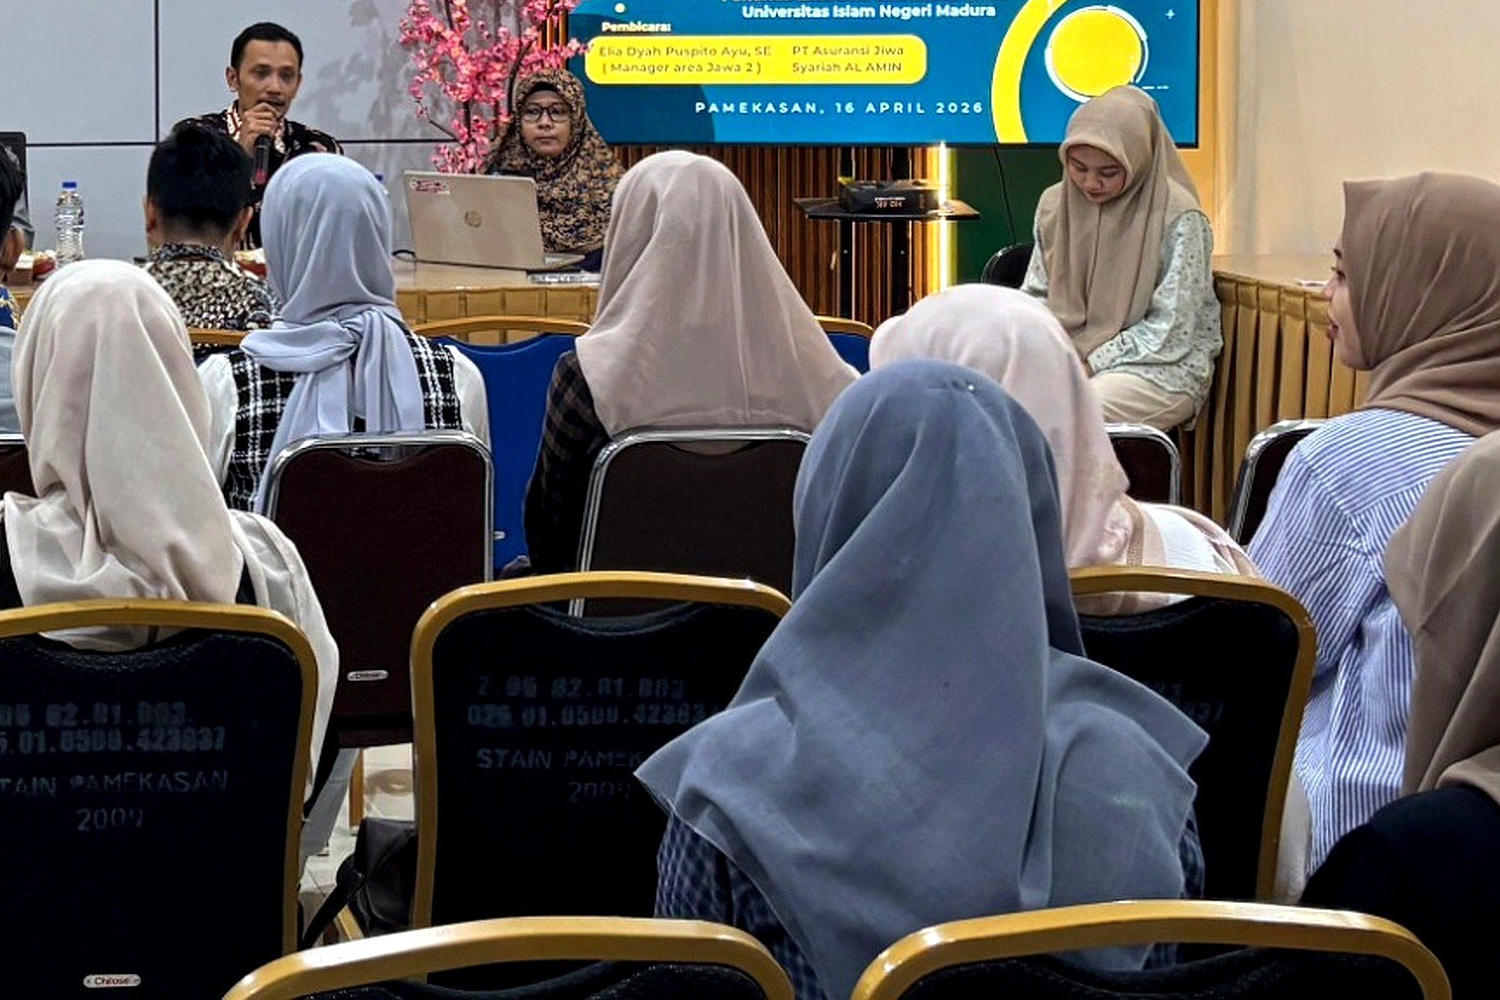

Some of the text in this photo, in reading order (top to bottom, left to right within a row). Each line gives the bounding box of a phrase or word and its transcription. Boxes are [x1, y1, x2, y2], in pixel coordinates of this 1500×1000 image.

[742, 3, 996, 20] Universitas Islam Negeri Madura
[601, 21, 672, 32] Pembicara:
[627, 46, 661, 59] Dyah
[666, 45, 717, 58] Puspito
[721, 46, 751, 58] Ayu,
[754, 46, 772, 56] SE
[792, 45, 904, 56] PT Asuransi Jiwa
[610, 63, 669, 75] Manager
[673, 63, 703, 73] area
[706, 62, 741, 73] Jawa
[745, 62, 753, 73] 2
[792, 62, 902, 74] Syariah AL AMIN
[695, 102, 983, 114] PAMEKASAN, 16 APRIL 2026
[476, 747, 645, 770] STAIN PAMEK
[69, 768, 229, 795] PAMEKASAN
